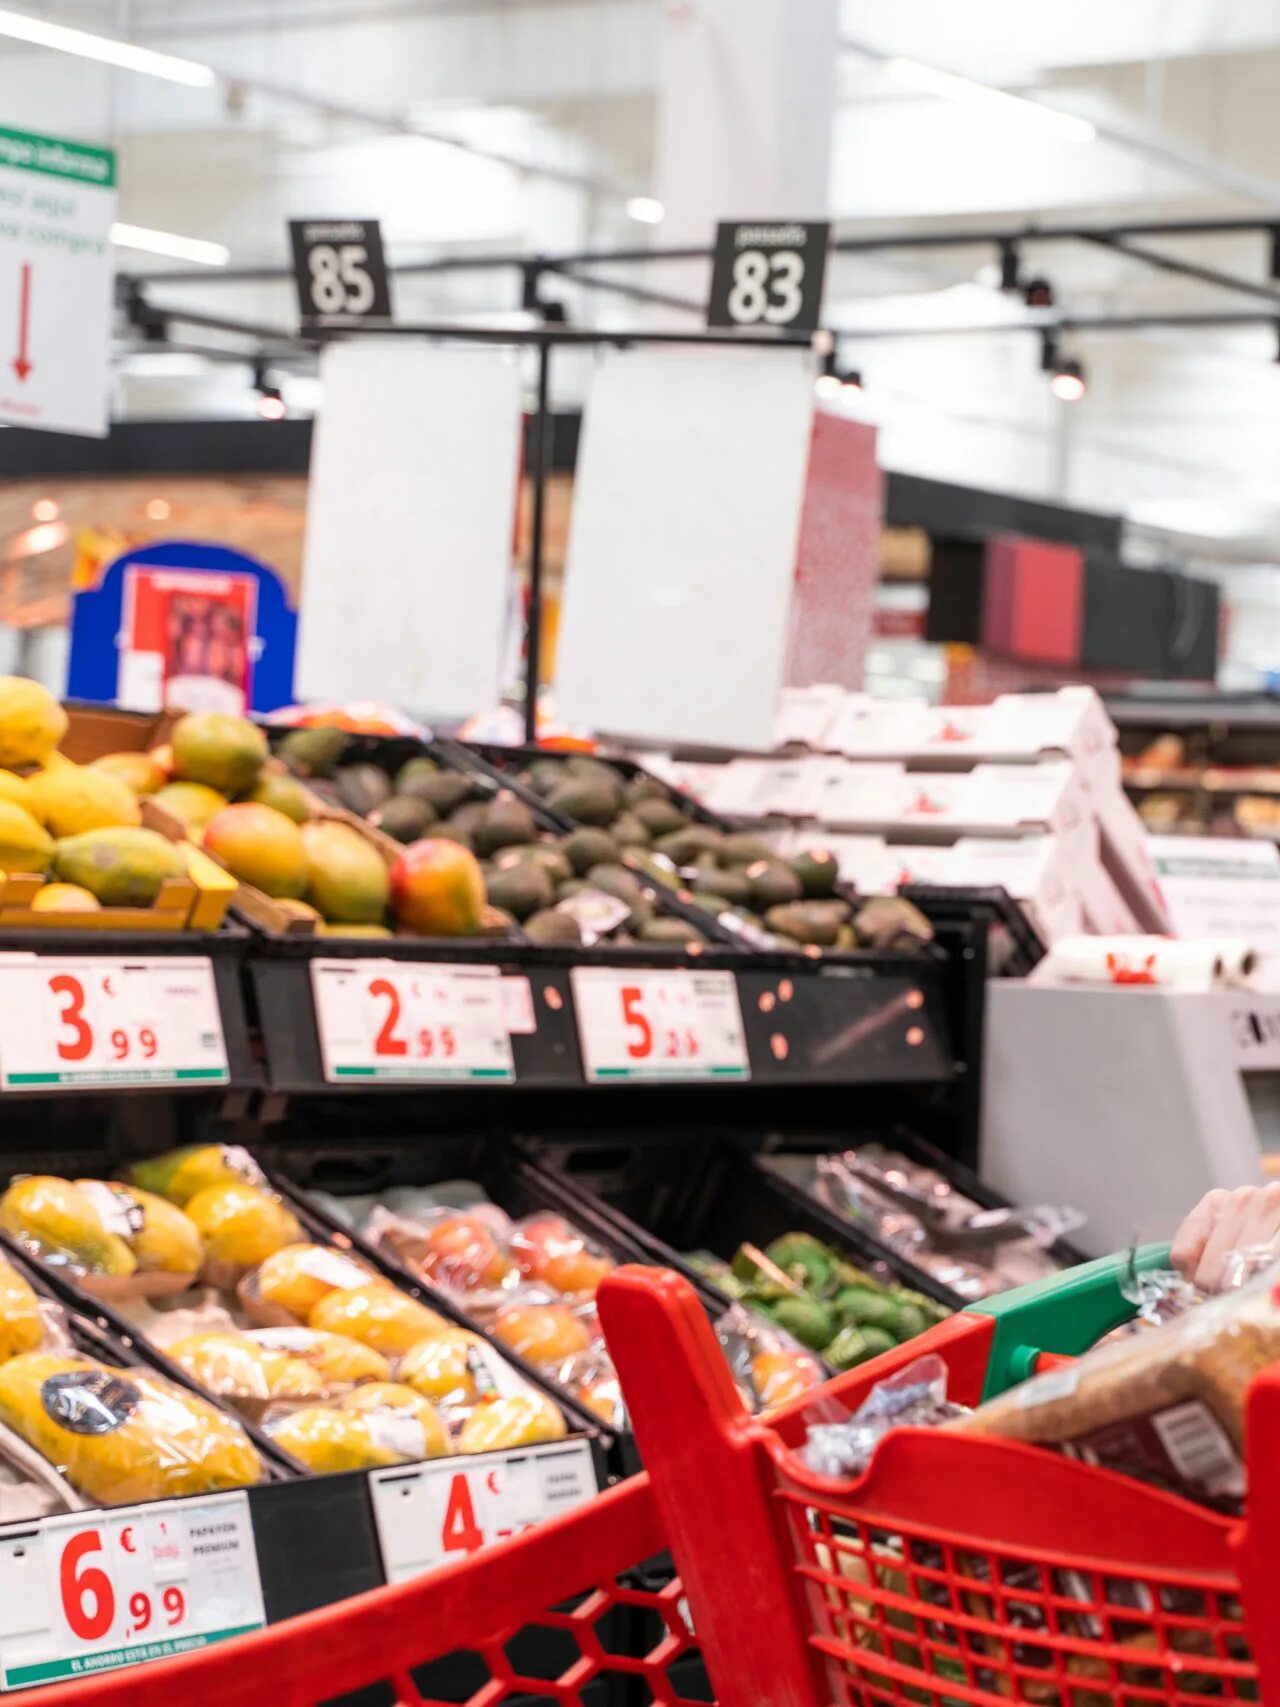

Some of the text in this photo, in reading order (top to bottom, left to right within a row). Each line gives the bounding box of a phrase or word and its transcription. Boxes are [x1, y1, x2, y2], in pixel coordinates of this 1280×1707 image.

[308, 244, 375, 314] 85
[728, 250, 805, 325] 83
[48, 974, 94, 1061] 3
[368, 979, 408, 1056] 2
[621, 987, 654, 1058] 5
[120, 1527, 136, 1553] €
[193, 1540, 240, 1555] PREMIUM
[442, 1473, 484, 1555] 4
[71, 1658, 83, 1672] EL
